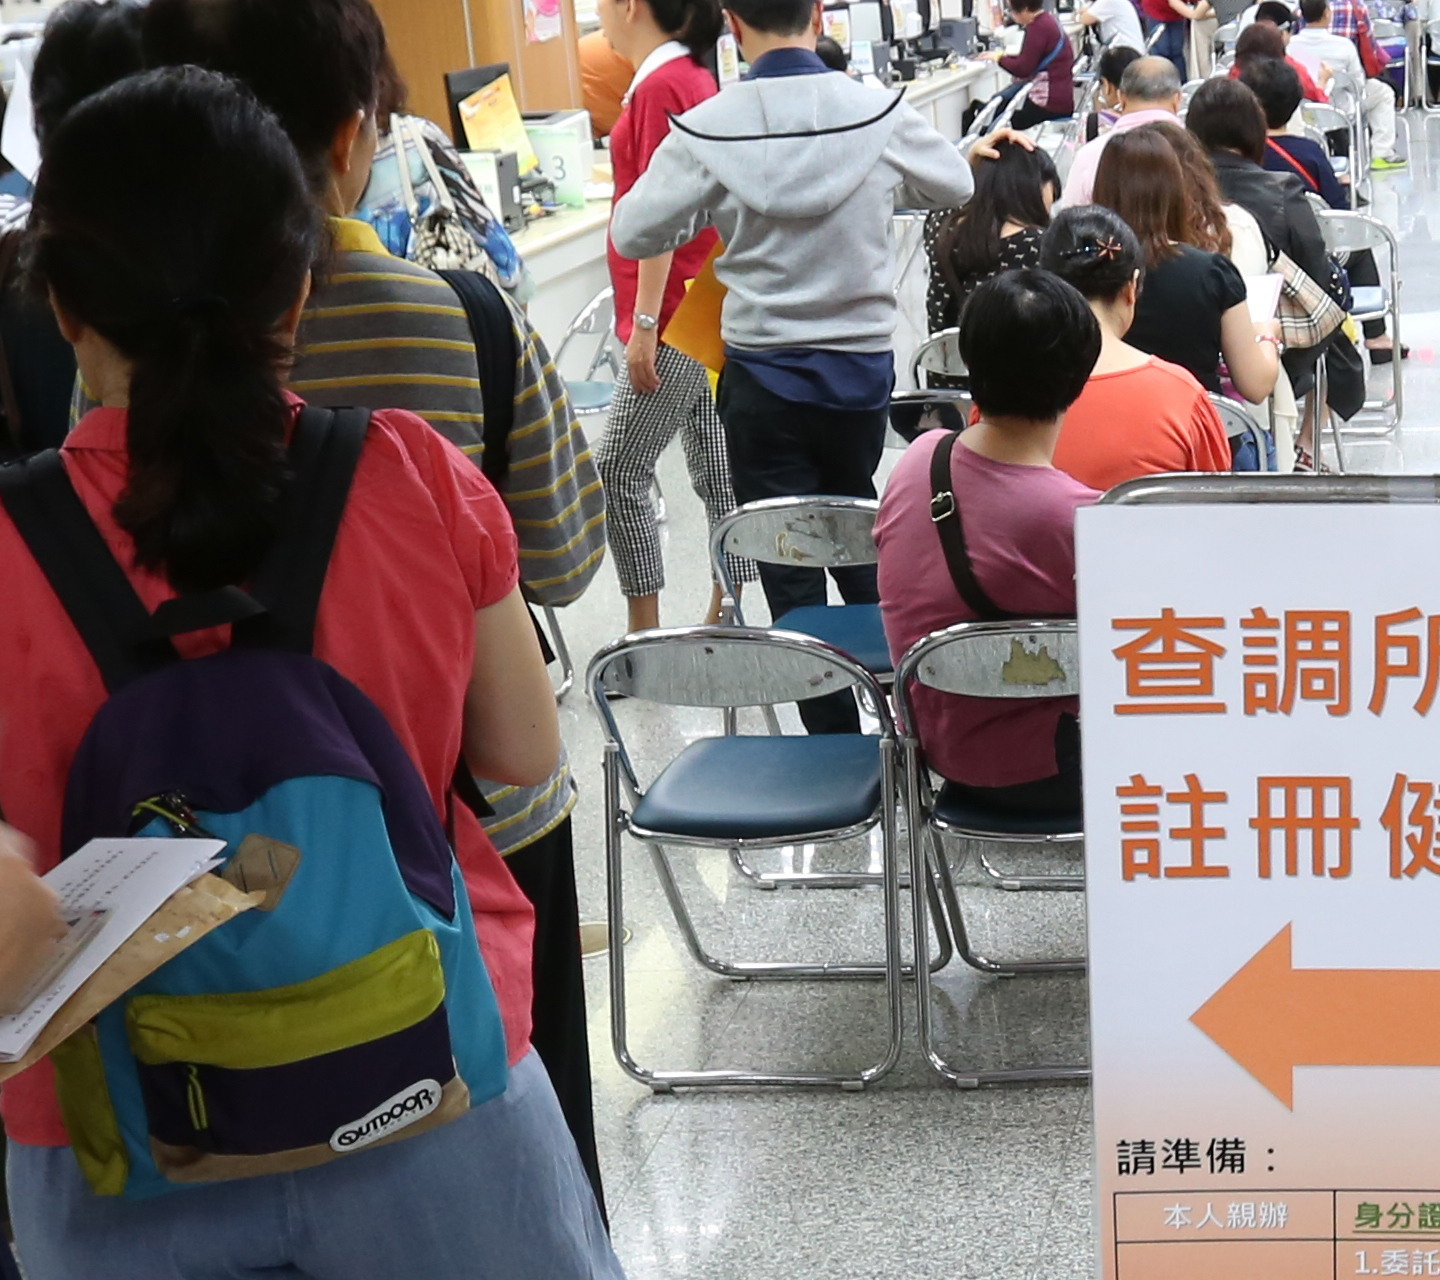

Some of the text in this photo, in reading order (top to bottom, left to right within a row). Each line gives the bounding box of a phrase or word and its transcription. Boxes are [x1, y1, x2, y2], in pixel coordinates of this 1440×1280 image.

[552, 156, 567, 181] 3
[1162, 1201, 1289, 1231] 本人親辦
